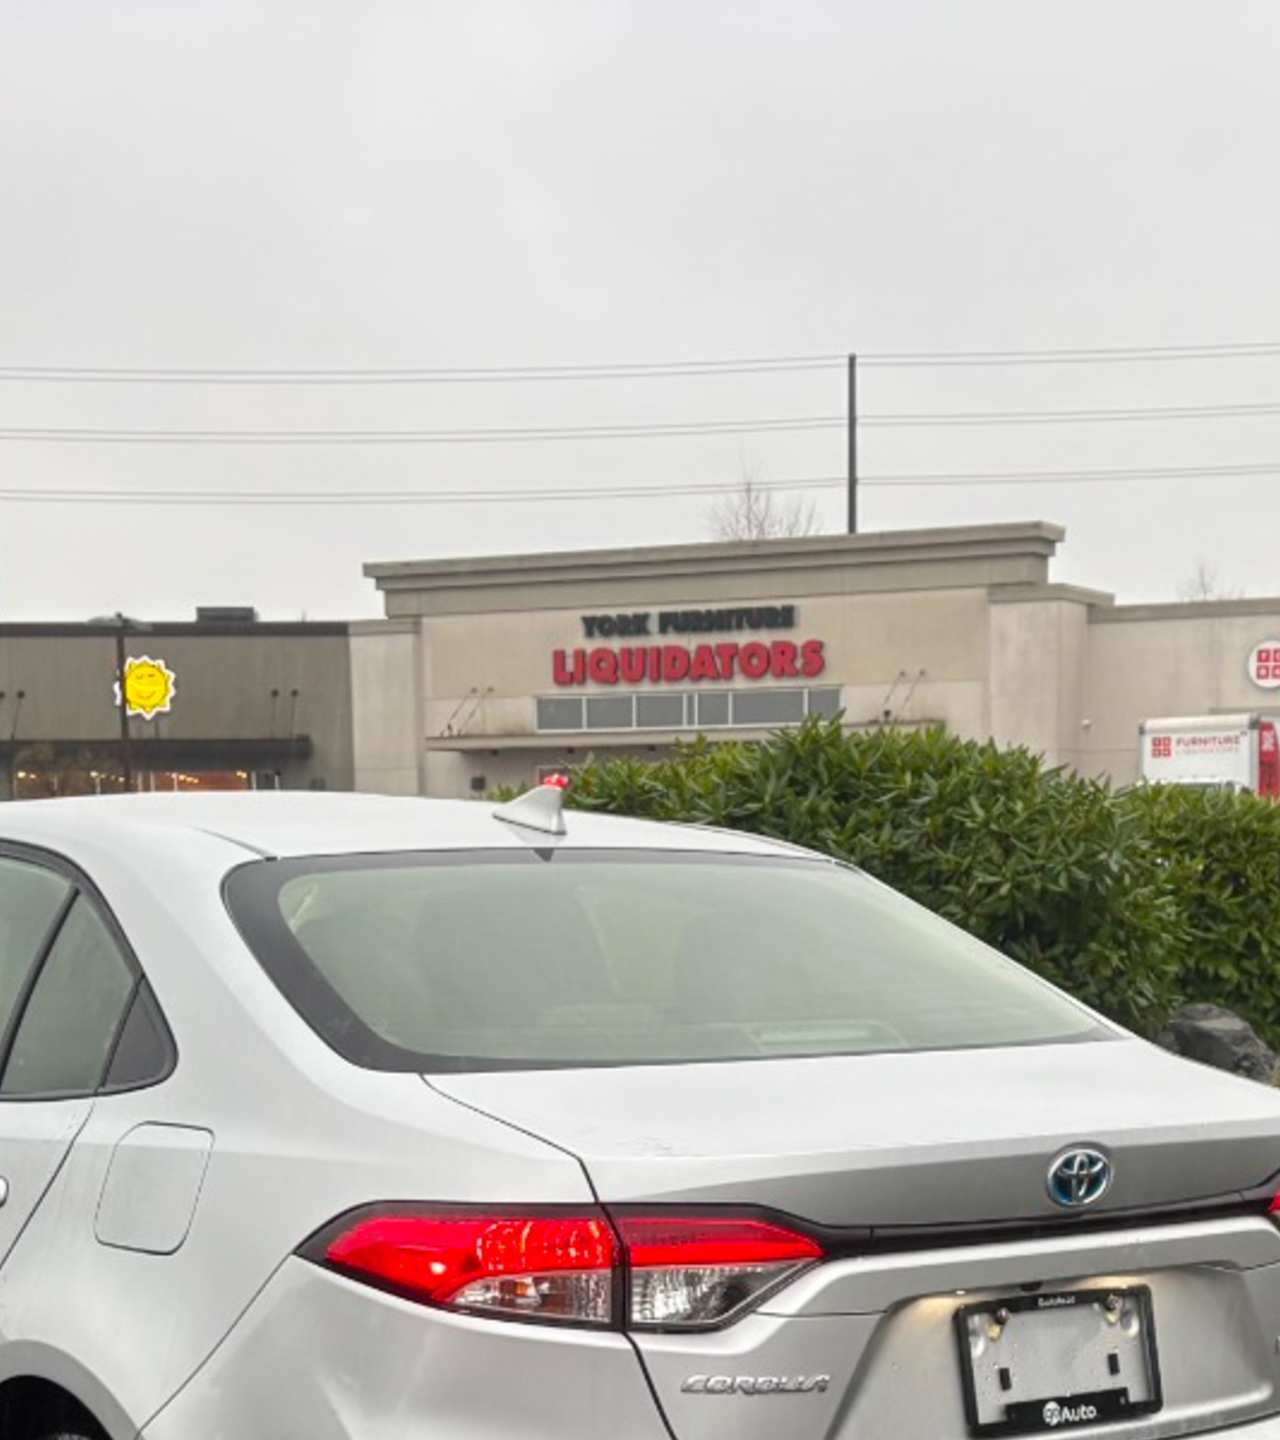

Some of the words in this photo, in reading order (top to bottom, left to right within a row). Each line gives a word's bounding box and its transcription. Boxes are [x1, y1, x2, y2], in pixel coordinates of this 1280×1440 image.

[582, 612, 650, 638] YORK
[658, 605, 795, 634] FURNITURE
[553, 639, 825, 686] LIQUIDATORS
[680, 1374, 831, 1395] COROLLA
